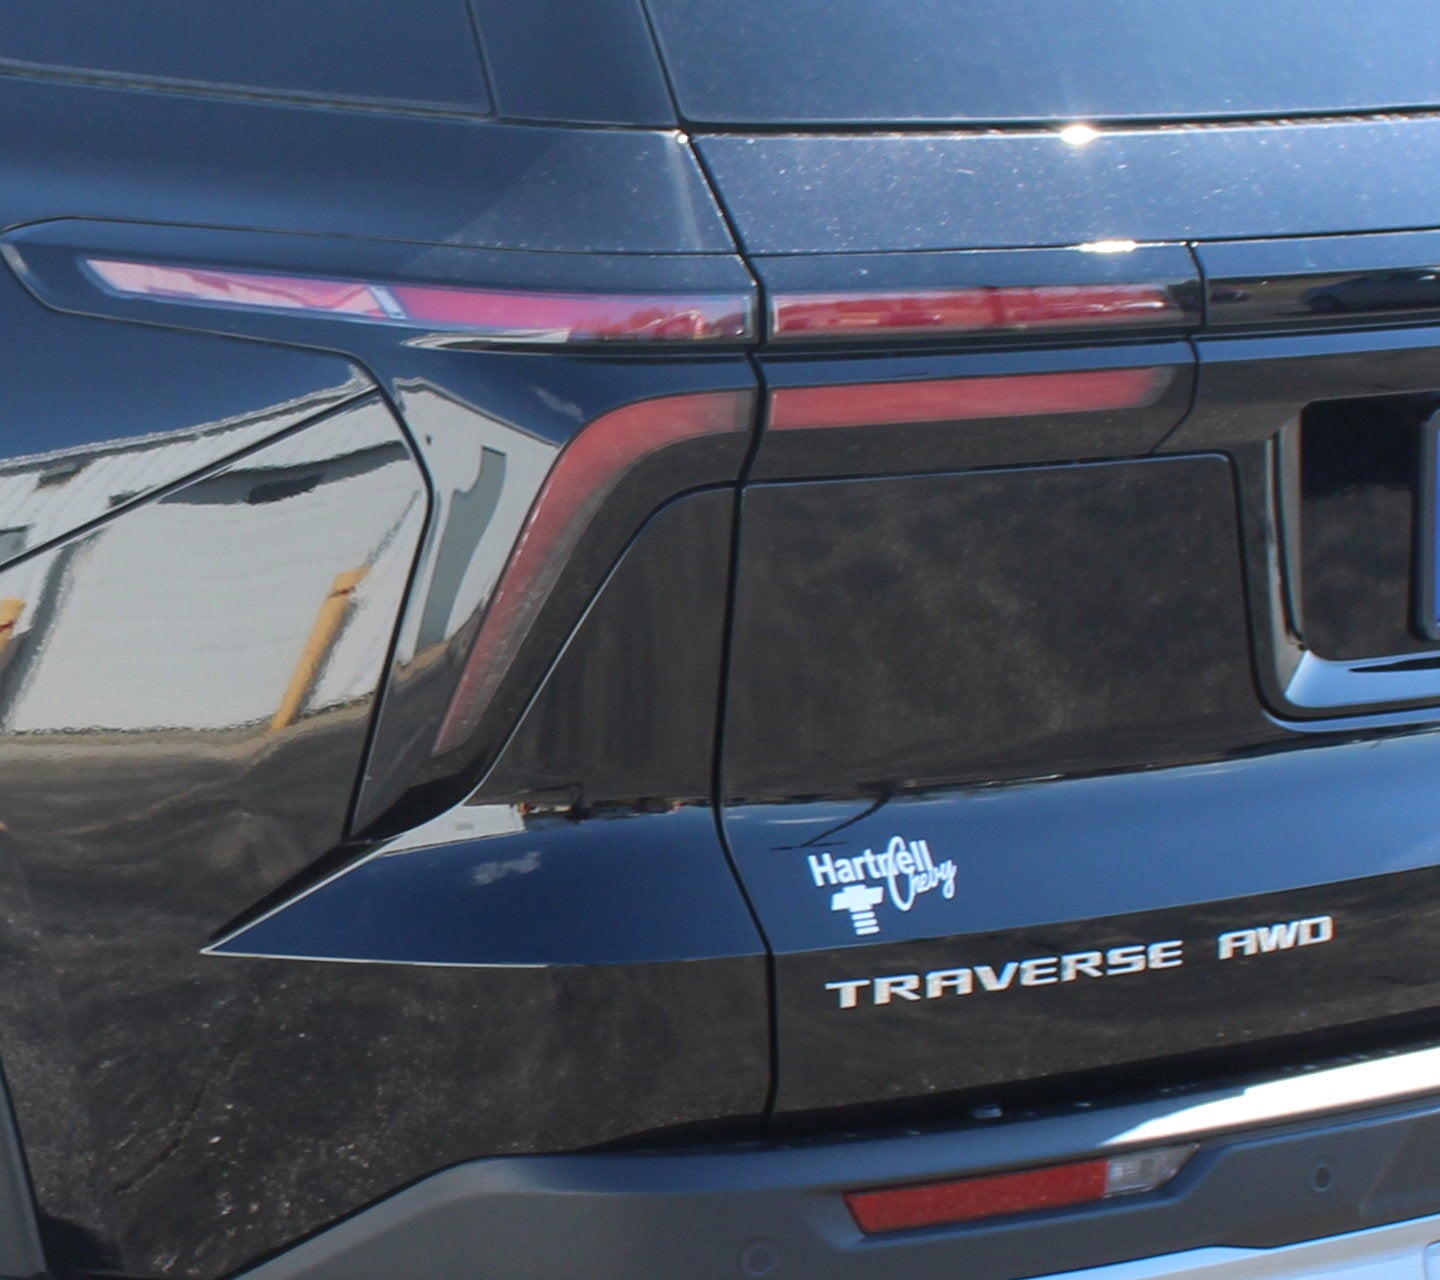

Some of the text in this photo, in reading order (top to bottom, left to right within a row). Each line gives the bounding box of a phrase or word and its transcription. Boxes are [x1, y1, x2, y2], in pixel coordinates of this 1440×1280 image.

[808, 839, 934, 888] Hartnell
[825, 915, 1334, 1010] TRAVERSE AWD
